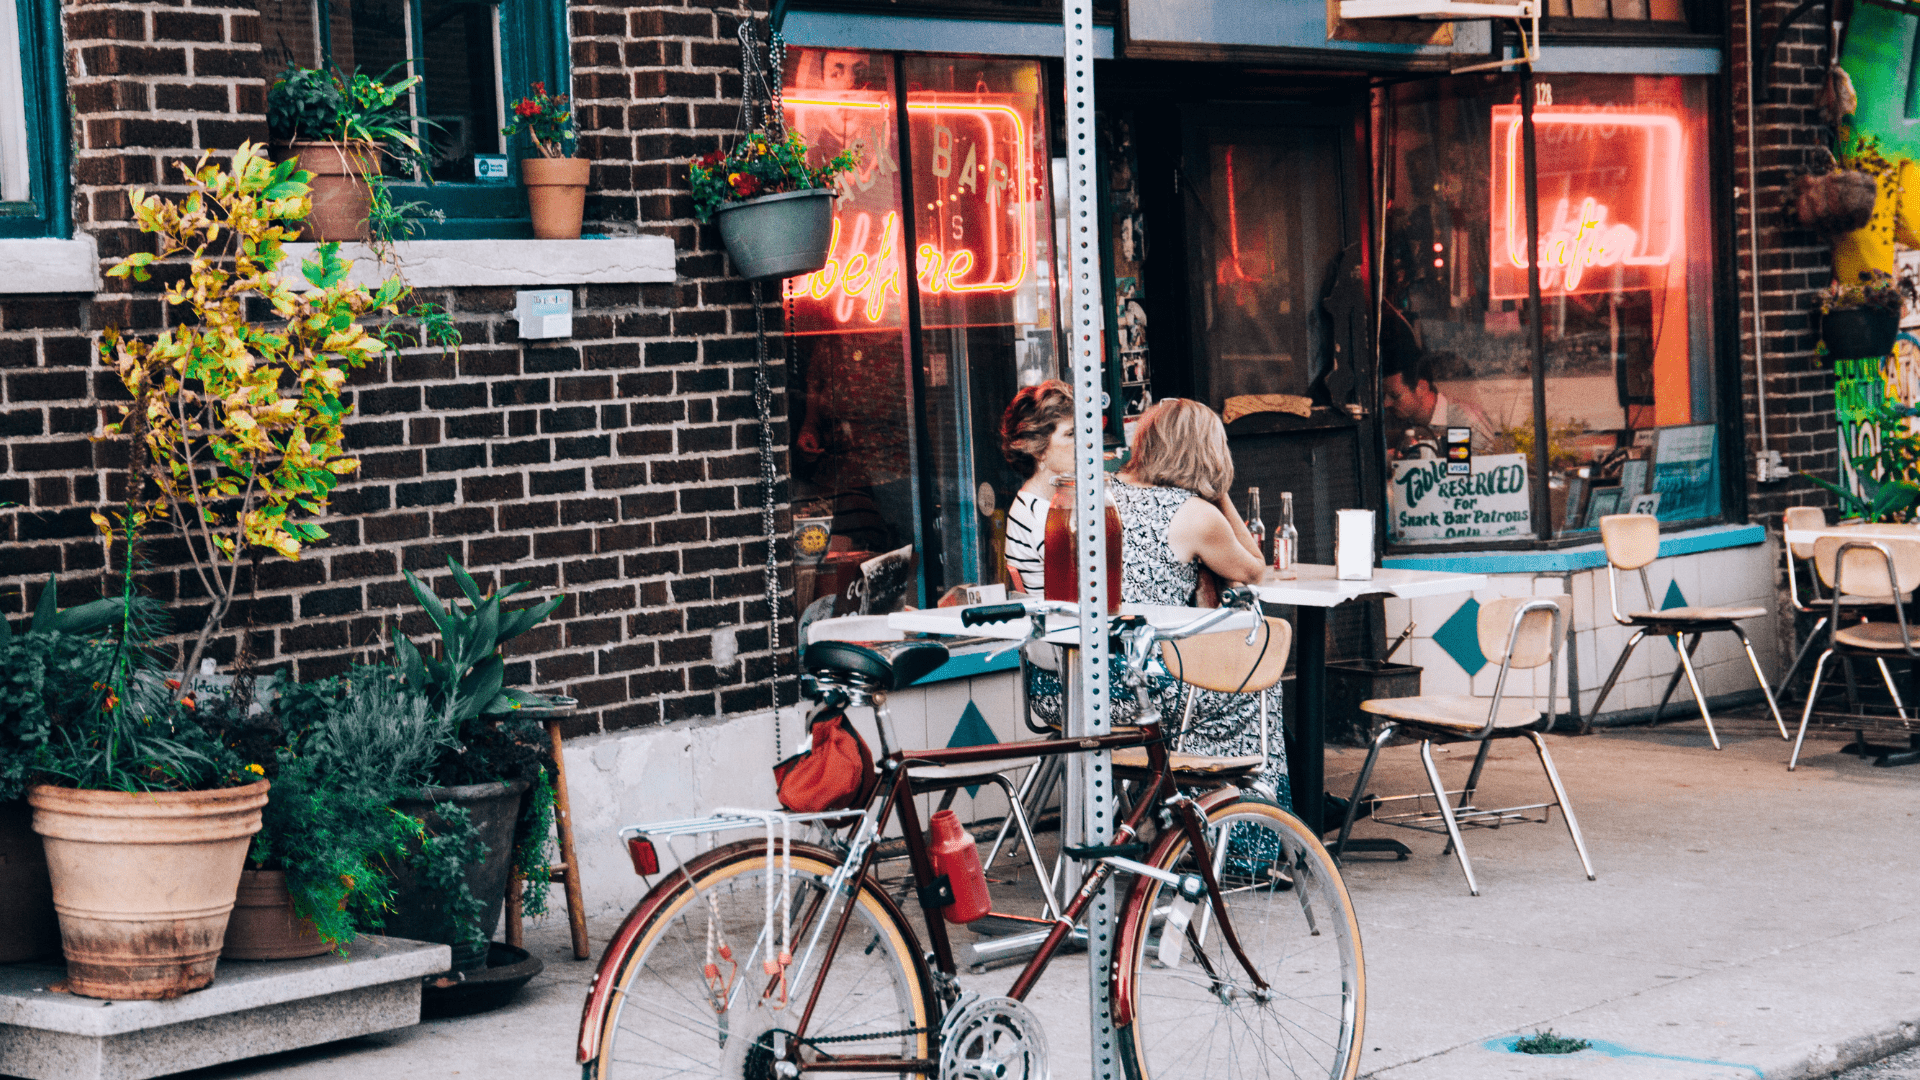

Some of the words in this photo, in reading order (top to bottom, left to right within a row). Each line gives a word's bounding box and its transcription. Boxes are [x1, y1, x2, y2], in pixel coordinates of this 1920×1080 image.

[1535, 83, 1552, 106] 128
[833, 120, 898, 211] ACK
[932, 124, 1008, 206] BAR
[1438, 464, 1524, 498] RESERVED
[1453, 498, 1477, 510] For
[1400, 511, 1440, 527] Snack
[1443, 511, 1471, 525] Bar
[1473, 510, 1528, 524] Patrons
